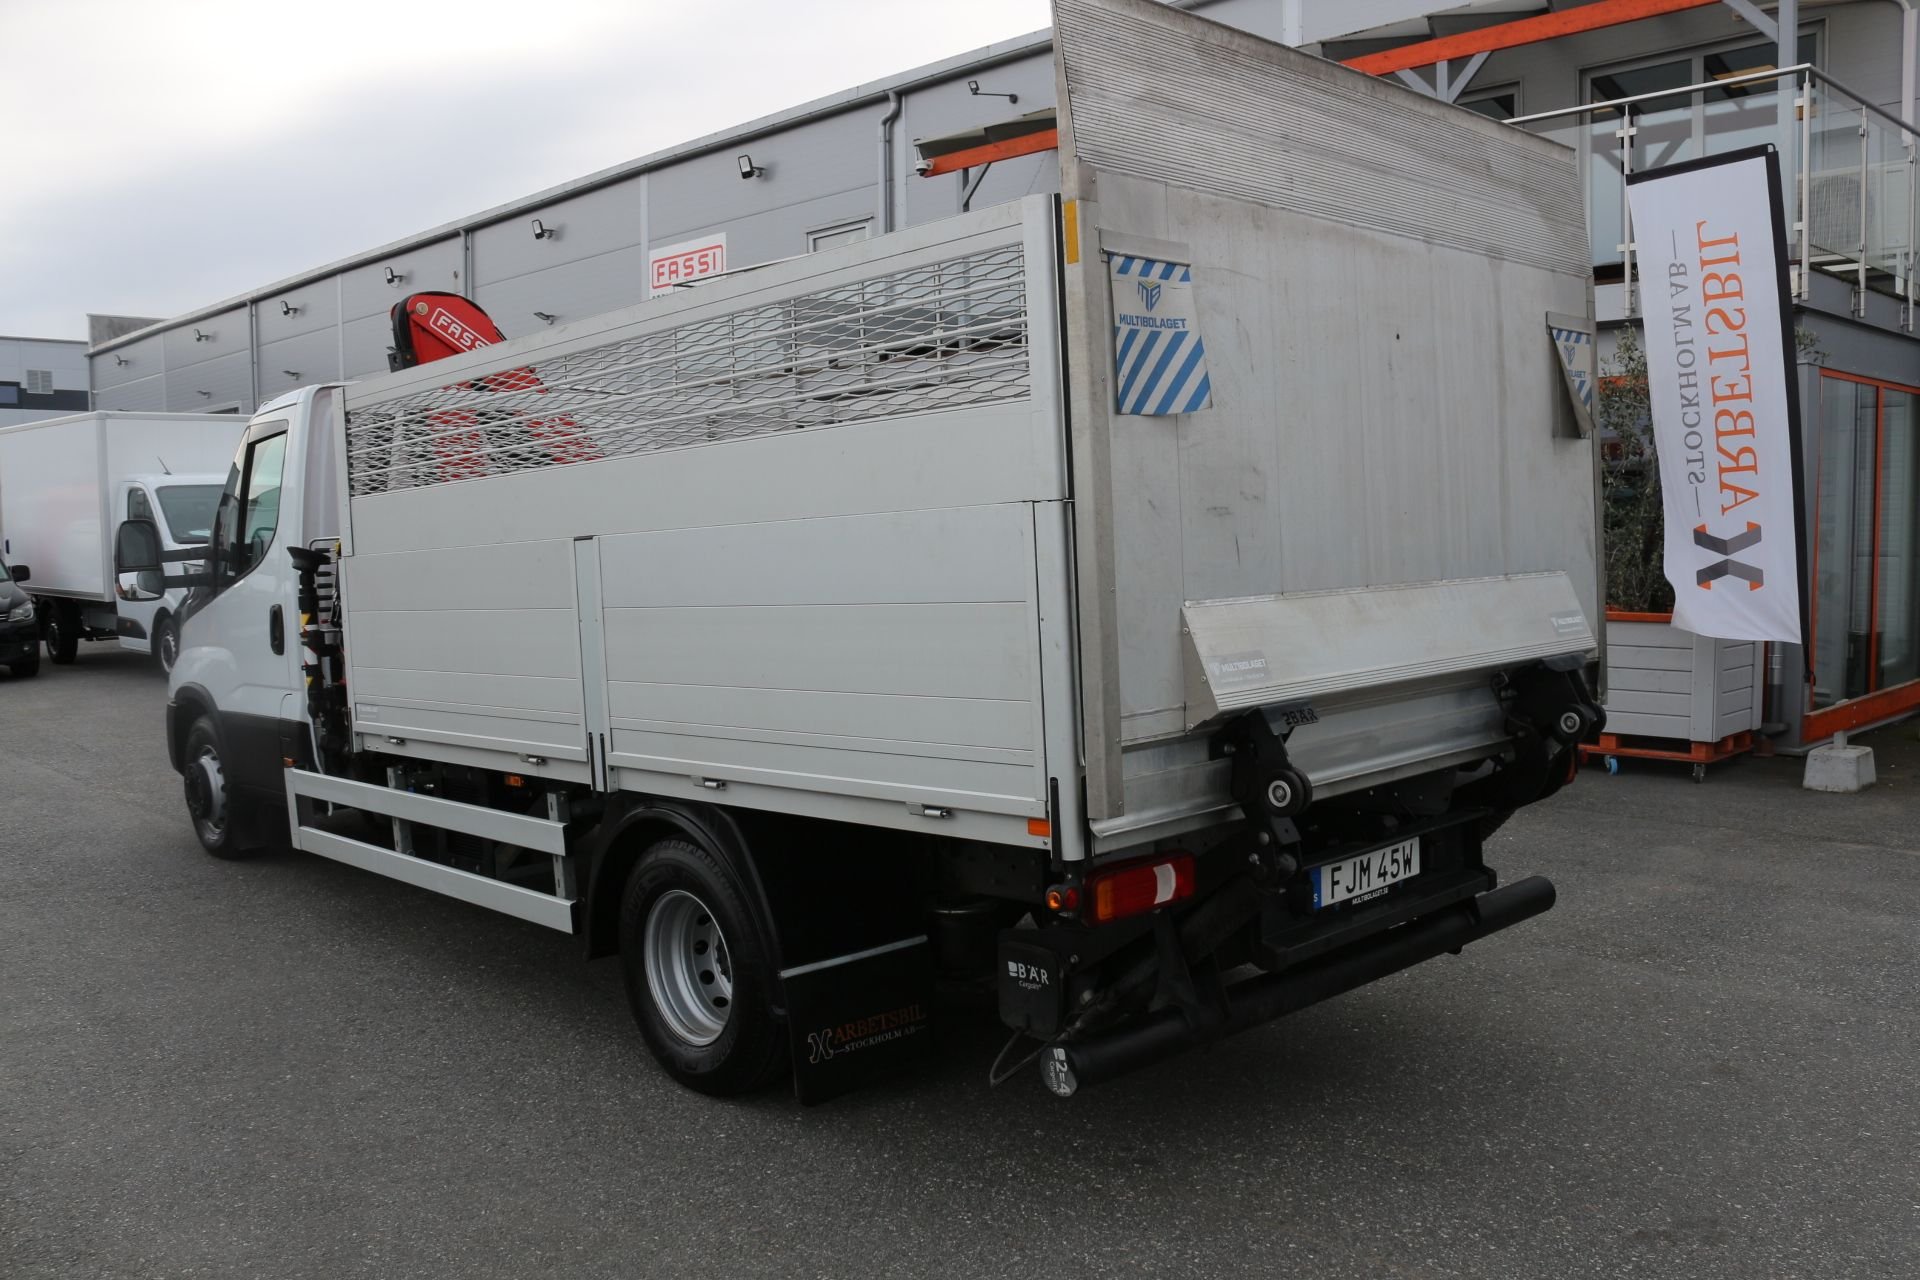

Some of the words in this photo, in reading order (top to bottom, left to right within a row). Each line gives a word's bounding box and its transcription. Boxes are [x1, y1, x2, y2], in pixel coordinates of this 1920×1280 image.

[656, 251, 716, 283] FASSI
[1119, 313, 1187, 329] MULTIBOLAGET
[1330, 856, 1371, 900] FJM
[1377, 842, 1413, 883] 45W
[1018, 962, 1049, 985] BÄR
[834, 1004, 927, 1044] ARBETSBIL
[845, 1029, 902, 1052] STOCKHOLM
